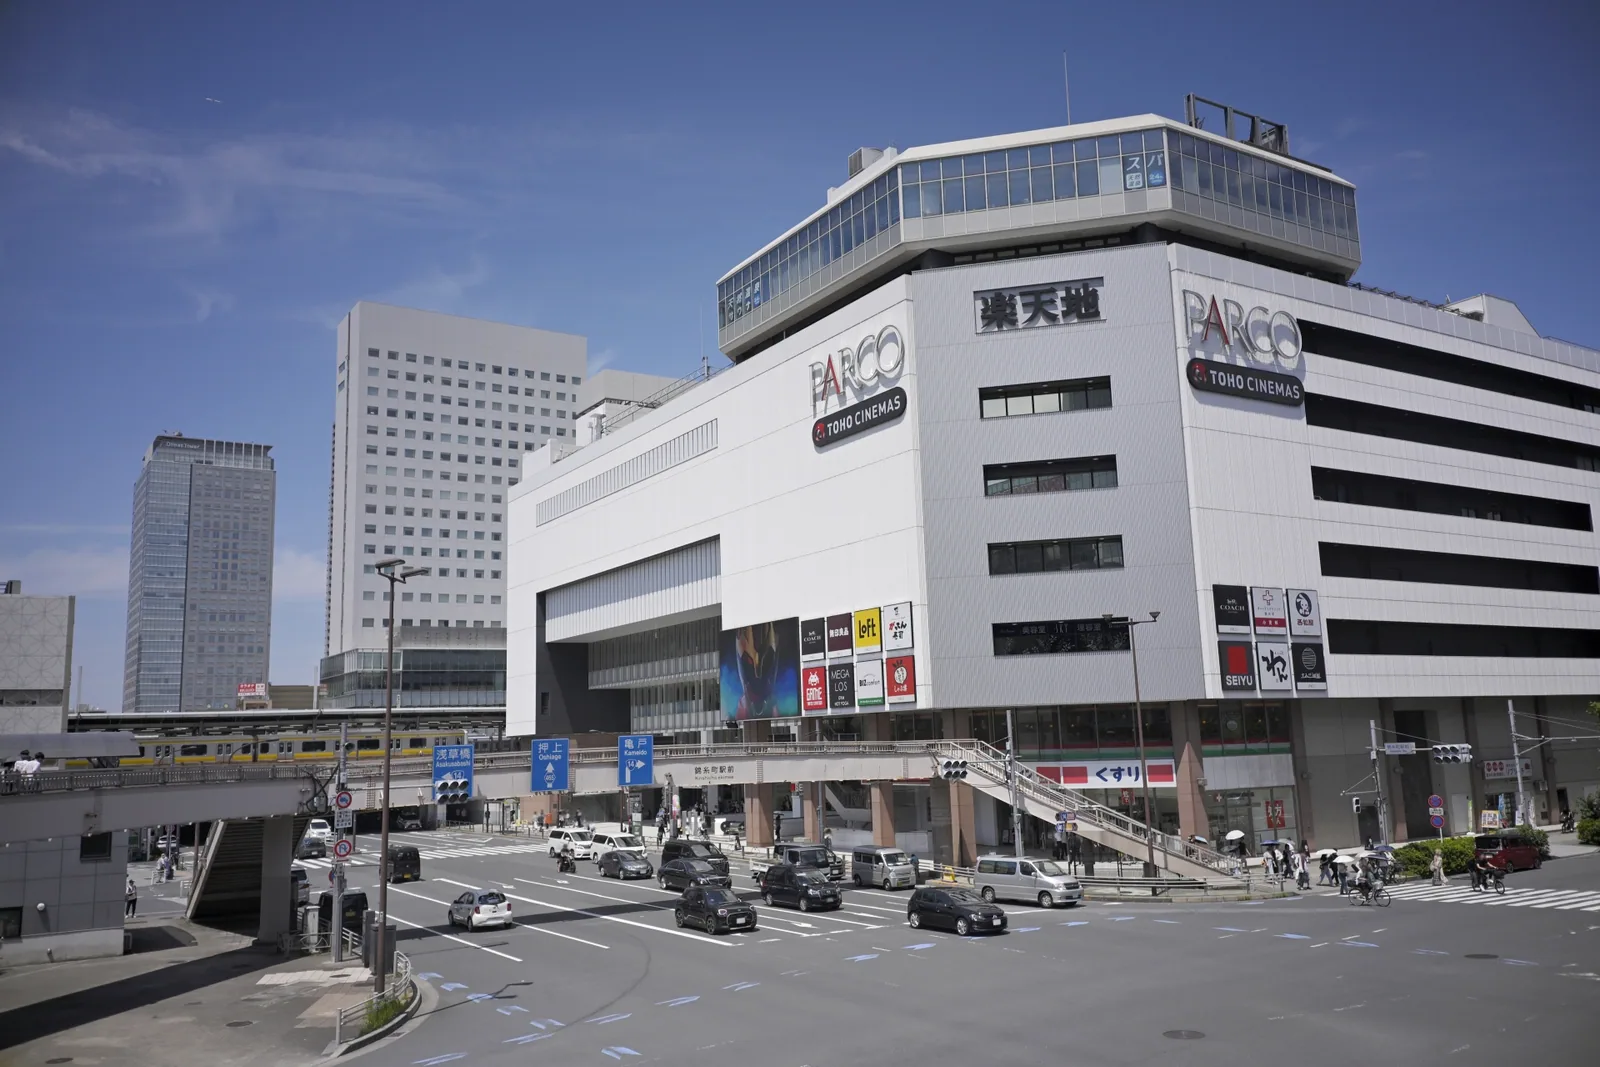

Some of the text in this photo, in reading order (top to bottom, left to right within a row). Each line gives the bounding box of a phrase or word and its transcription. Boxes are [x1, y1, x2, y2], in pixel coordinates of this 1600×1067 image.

[1127, 154, 1163, 171] スパ
[980, 282, 1101, 329] 楽天地
[1182, 289, 1303, 359] PARCO
[808, 324, 904, 404] PARCO
[1210, 370, 1300, 399] TOHO CINEMAS
[827, 395, 901, 436] TOHO CINEMAS
[1219, 604, 1245, 612] COACH
[830, 669, 850, 680] MEGA
[1225, 675, 1253, 686] SEIYU
[834, 682, 848, 692] LOS
[538, 742, 563, 753] 押上
[624, 738, 648, 750] 亀戸
[436, 748, 470, 760] 浅草橋
[436, 760, 471, 768] Asakusabashi
[694, 765, 735, 774] 錦糸町駅前
[1096, 766, 1140, 782] くすり
